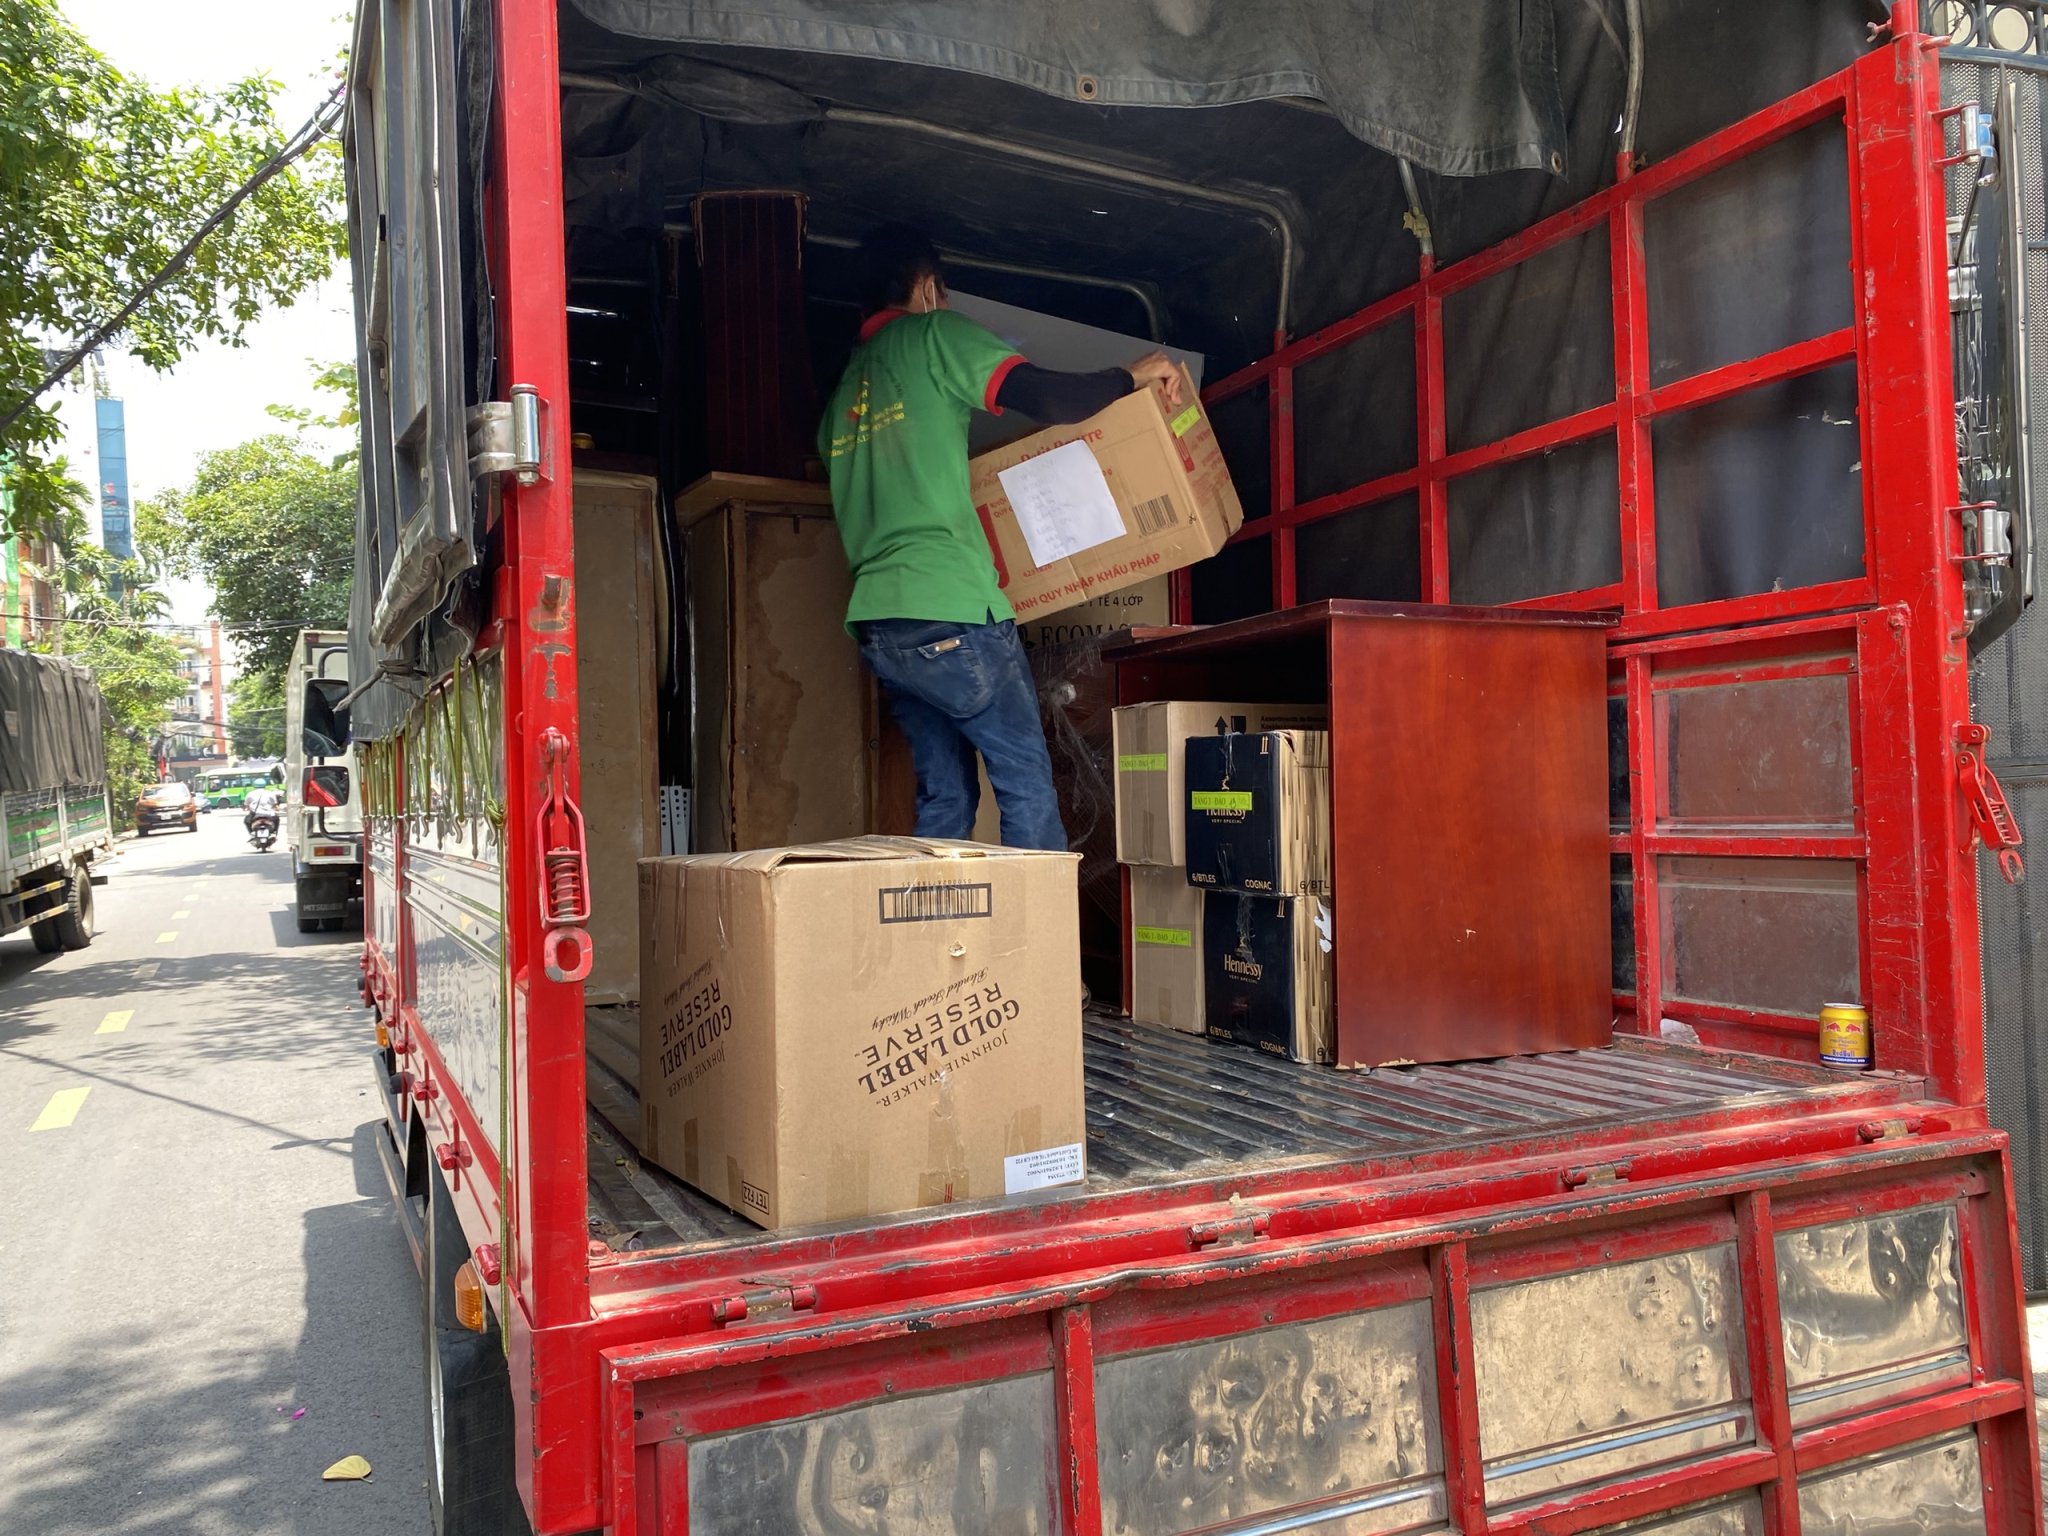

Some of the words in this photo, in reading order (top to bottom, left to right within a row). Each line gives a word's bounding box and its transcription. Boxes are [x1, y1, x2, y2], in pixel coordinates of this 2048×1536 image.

[1191, 873, 1217, 884] 6/BTLES
[1244, 878, 1273, 890] COGNAC
[945, 966, 989, 998] Blended
[1224, 953, 1264, 980] Hennessy
[660, 977, 721, 1047] RESERVE
[697, 1004, 732, 1049] GOLD
[861, 982, 1003, 1067] RESERVE
[872, 1006, 914, 1033] Whisky
[952, 999, 1020, 1047] GOLD
[660, 1031, 697, 1078] LABEL
[858, 1035, 949, 1095] LABEL
[943, 1028, 1009, 1073] JOHNNIE
[1260, 1040, 1287, 1057] COGNAC
